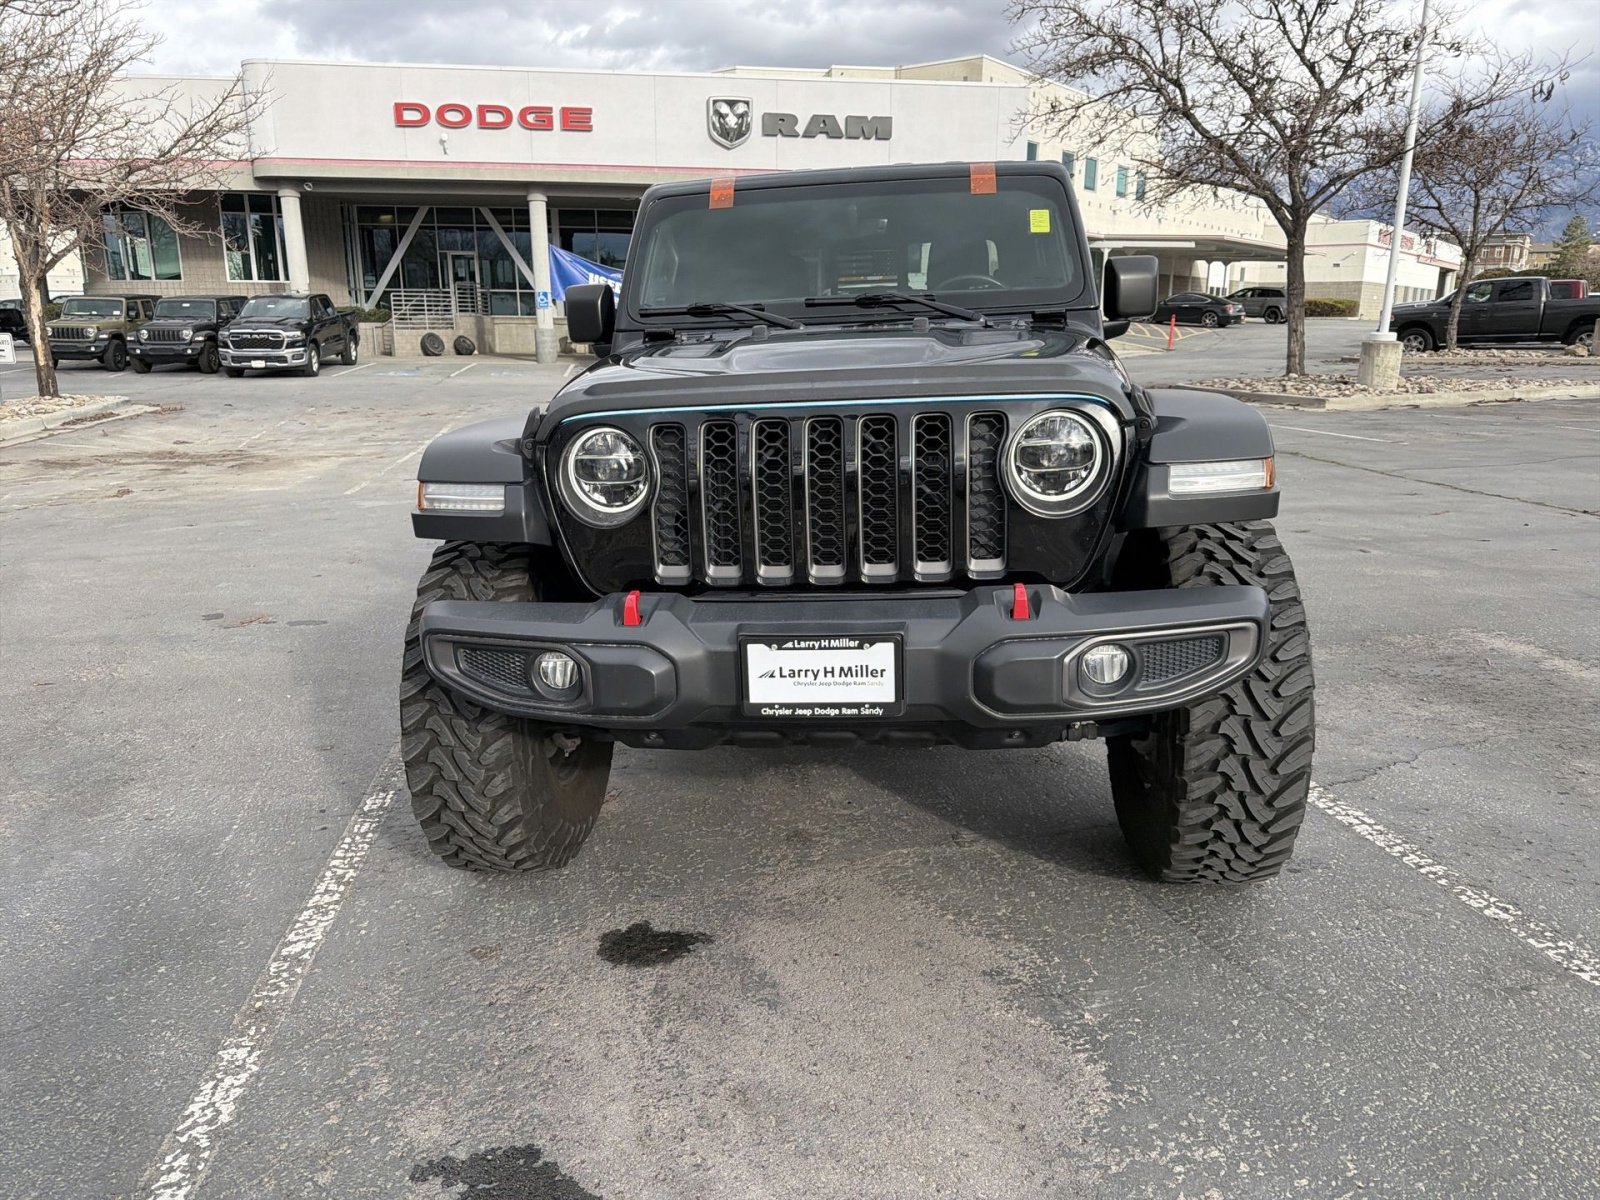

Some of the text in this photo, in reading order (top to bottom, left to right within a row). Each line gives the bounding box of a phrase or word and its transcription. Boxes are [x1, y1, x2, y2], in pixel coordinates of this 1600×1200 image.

[394, 102, 593, 132] DODGE
[762, 112, 893, 140] RAM
[794, 638, 860, 650] Larry H Miller
[779, 664, 887, 681] Larry H Miller
[761, 706, 884, 716] Chrysler Jeep Dodge Ram Sandy
